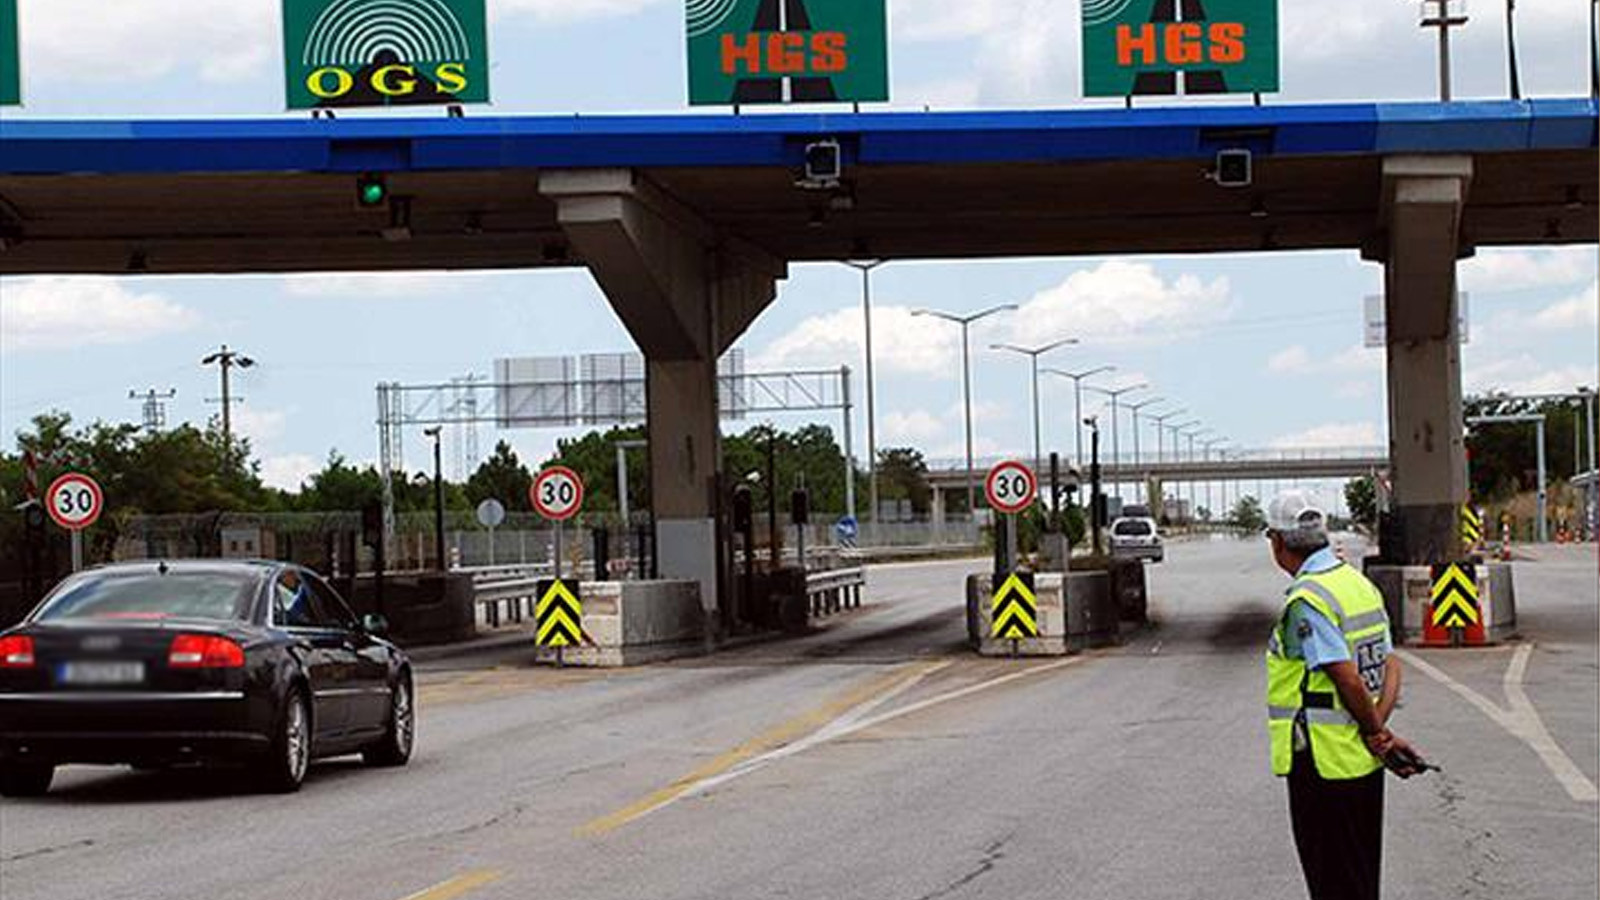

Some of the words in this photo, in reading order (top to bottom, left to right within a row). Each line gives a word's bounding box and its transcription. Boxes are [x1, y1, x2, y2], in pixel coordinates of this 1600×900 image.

[721, 31, 847, 73] HGS
[1116, 22, 1245, 65] HGS
[306, 63, 467, 98] OGS
[542, 481, 573, 505] 30
[997, 474, 1027, 498] 30
[59, 489, 92, 514] 30
